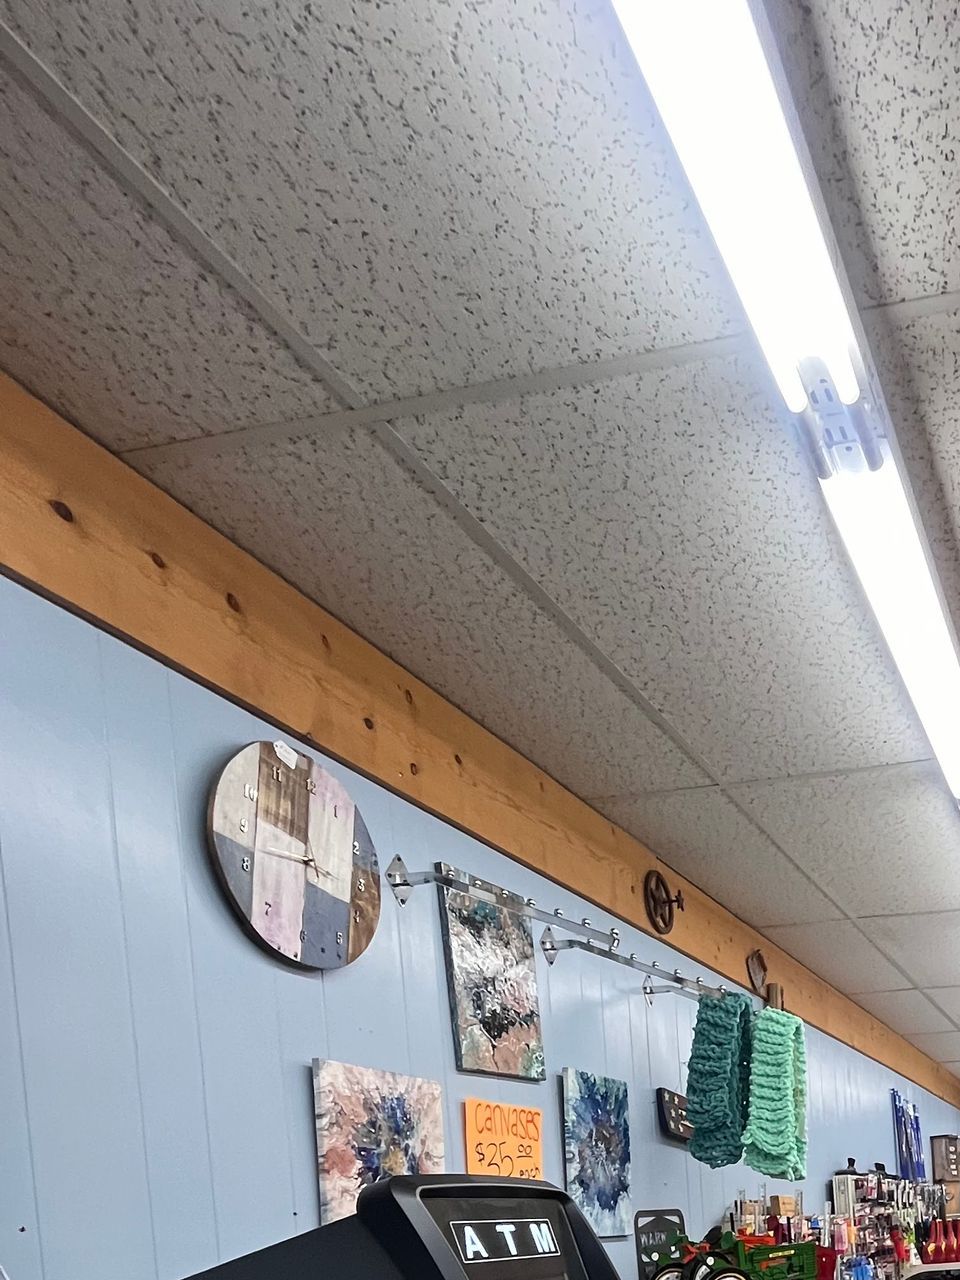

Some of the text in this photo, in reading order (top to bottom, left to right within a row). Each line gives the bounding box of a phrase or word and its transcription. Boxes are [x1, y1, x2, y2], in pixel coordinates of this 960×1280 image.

[271, 766, 283, 782] 11
[305, 778, 317, 795] 12
[240, 817, 249, 833] 9
[352, 840, 361, 856] 2
[241, 857, 250, 871] 8
[264, 901, 272, 916] 7
[474, 1103, 541, 1142] canvases
[464, 1223, 556, 1259] ATM
